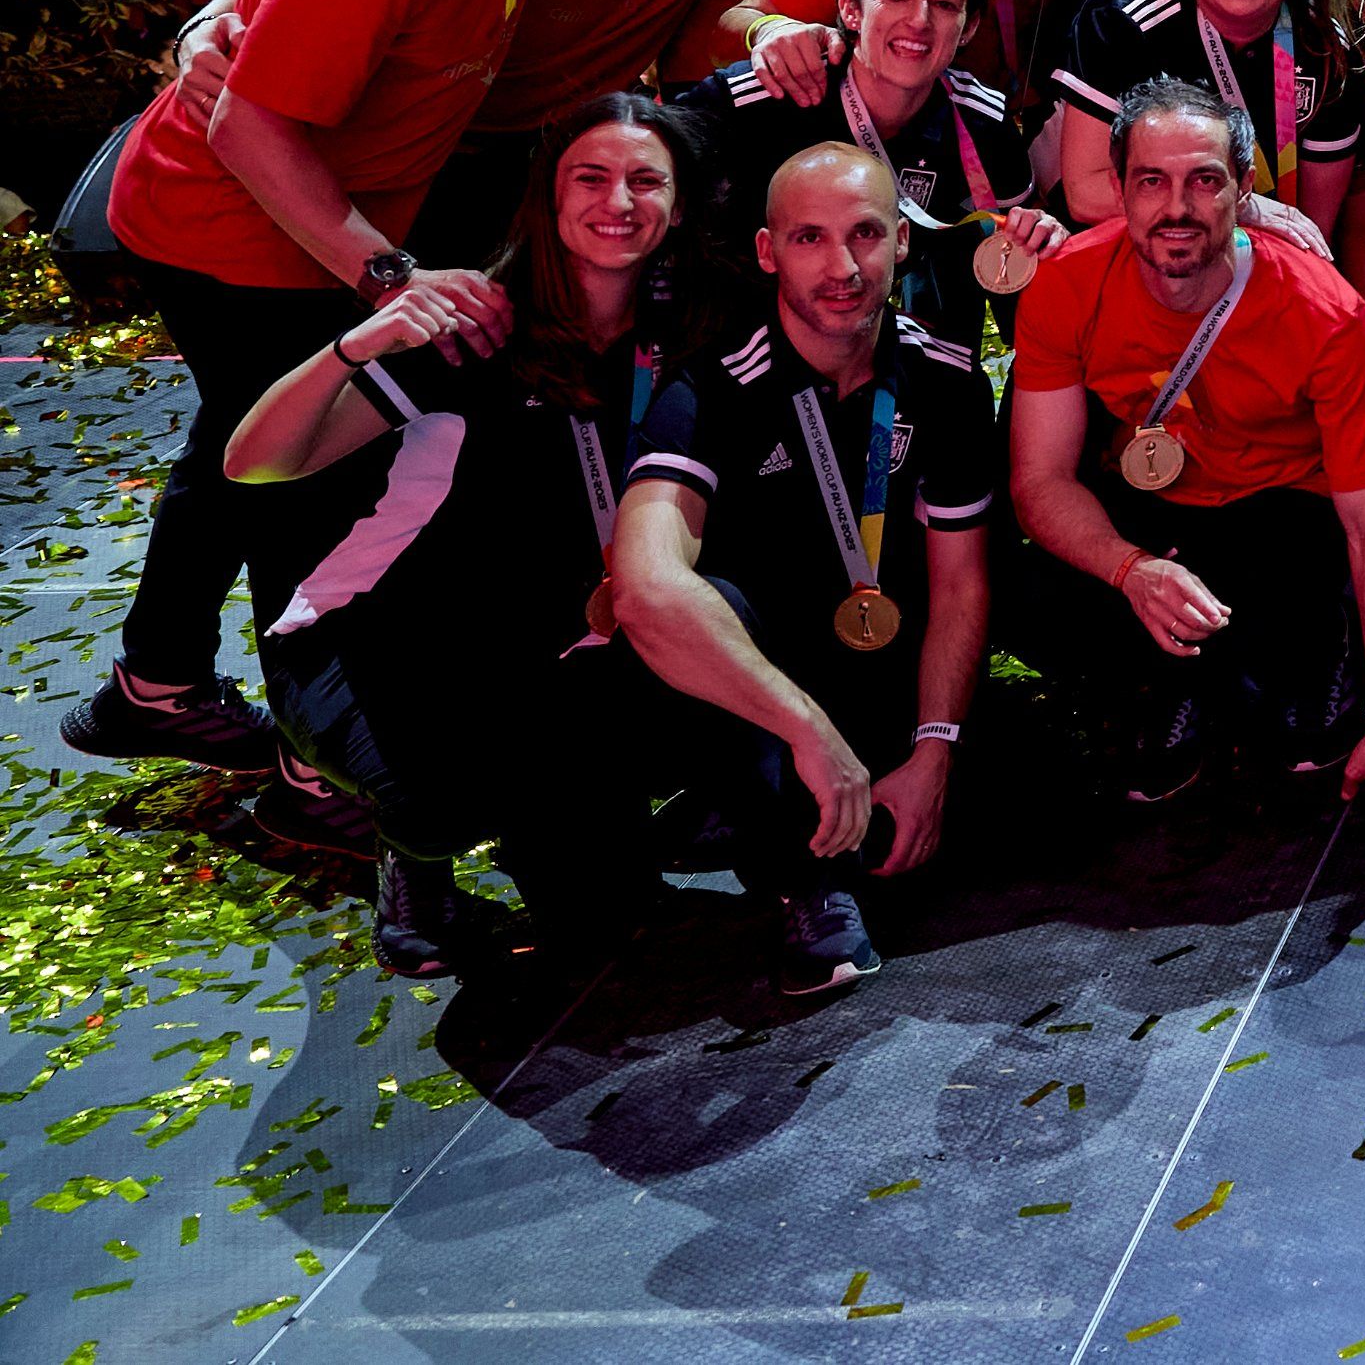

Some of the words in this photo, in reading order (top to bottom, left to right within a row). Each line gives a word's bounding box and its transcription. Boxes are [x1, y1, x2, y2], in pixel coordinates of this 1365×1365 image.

[850, 98, 866, 132] WORLD
[862, 133, 874, 150] CUP
[1214, 300, 1230, 317] FIFA
[580, 426, 592, 446] CUP
[801, 393, 820, 438] WOMEN'S
[815, 438, 831, 472] WORLD
[823, 473, 838, 491] CUP
[759, 459, 793, 475] adidas
